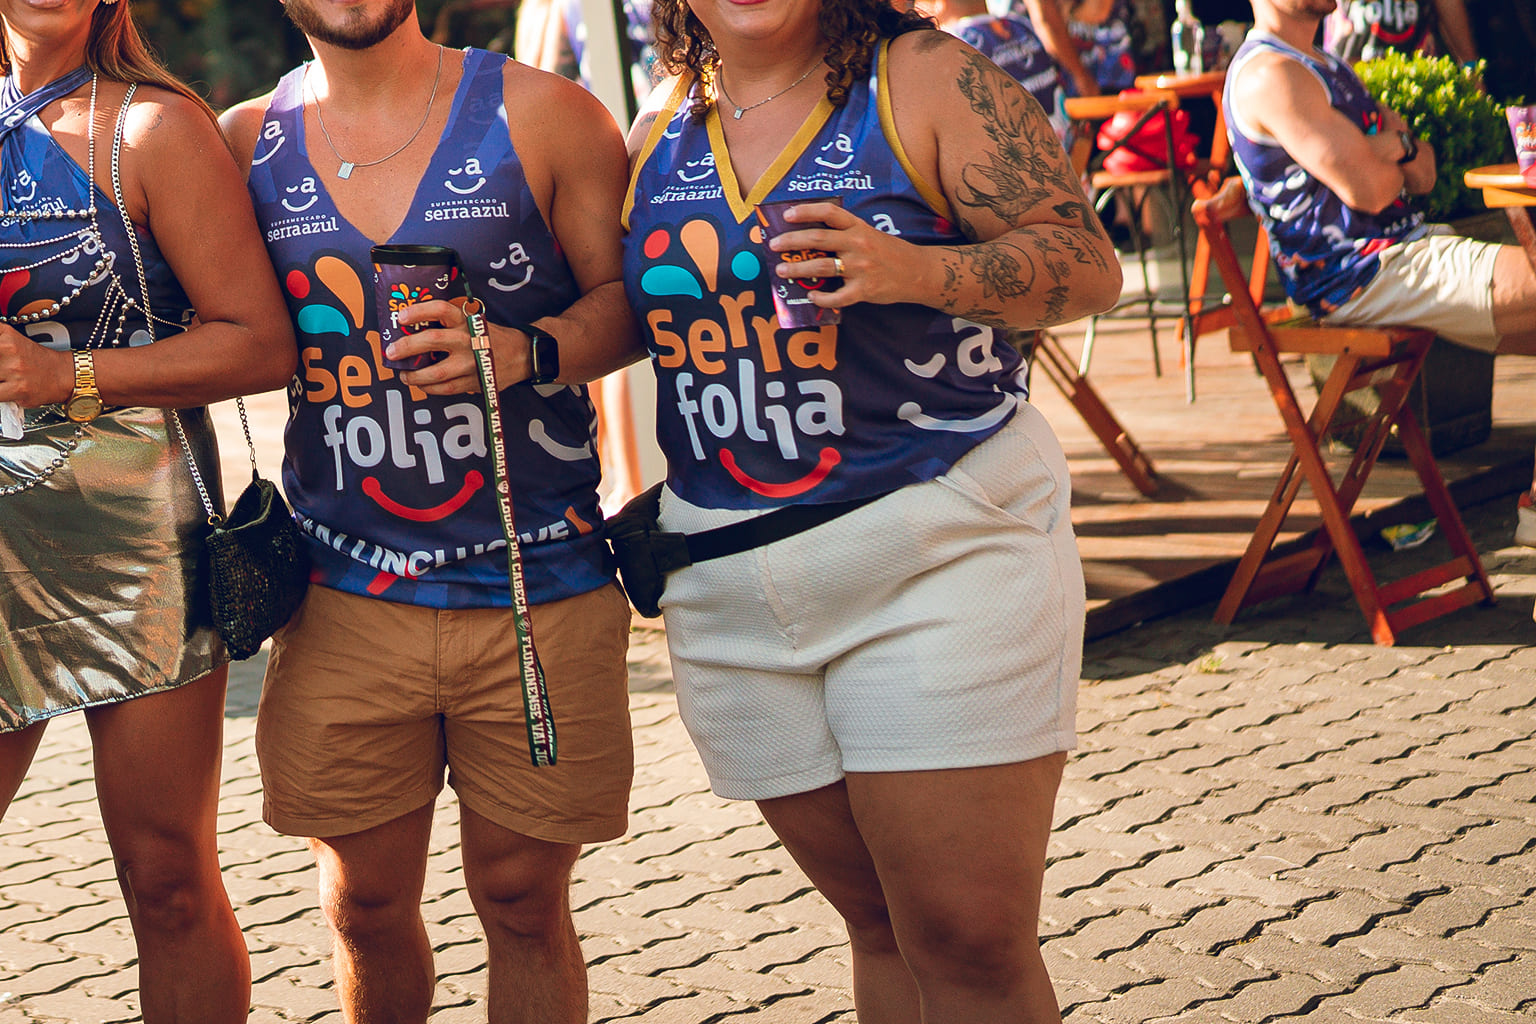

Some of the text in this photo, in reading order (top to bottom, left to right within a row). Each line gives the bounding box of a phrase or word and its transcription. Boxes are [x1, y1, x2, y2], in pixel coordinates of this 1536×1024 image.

[666, 184, 715, 193] ERMERCADO
[787, 174, 875, 192] serraazul
[424, 202, 510, 222] serraazul
[431, 198, 497, 207] SUPERMERCADO
[267, 216, 339, 243] serraazul
[270, 214, 326, 228] SUPERMERCADO
[388, 298, 417, 312] ser
[648, 289, 838, 375] serra
[302, 331, 428, 408] ser
[490, 409, 503, 434] VAI
[676, 357, 846, 461] folia
[323, 389, 488, 491] folia
[493, 437, 507, 477] JOGAR
[499, 496, 515, 539] LOUCO
[510, 541, 520, 560] DA
[302, 519, 569, 577] #ALLINCLUVE
[521, 636, 542, 719] FLUMINENSE
[531, 722, 546, 745] VAI
